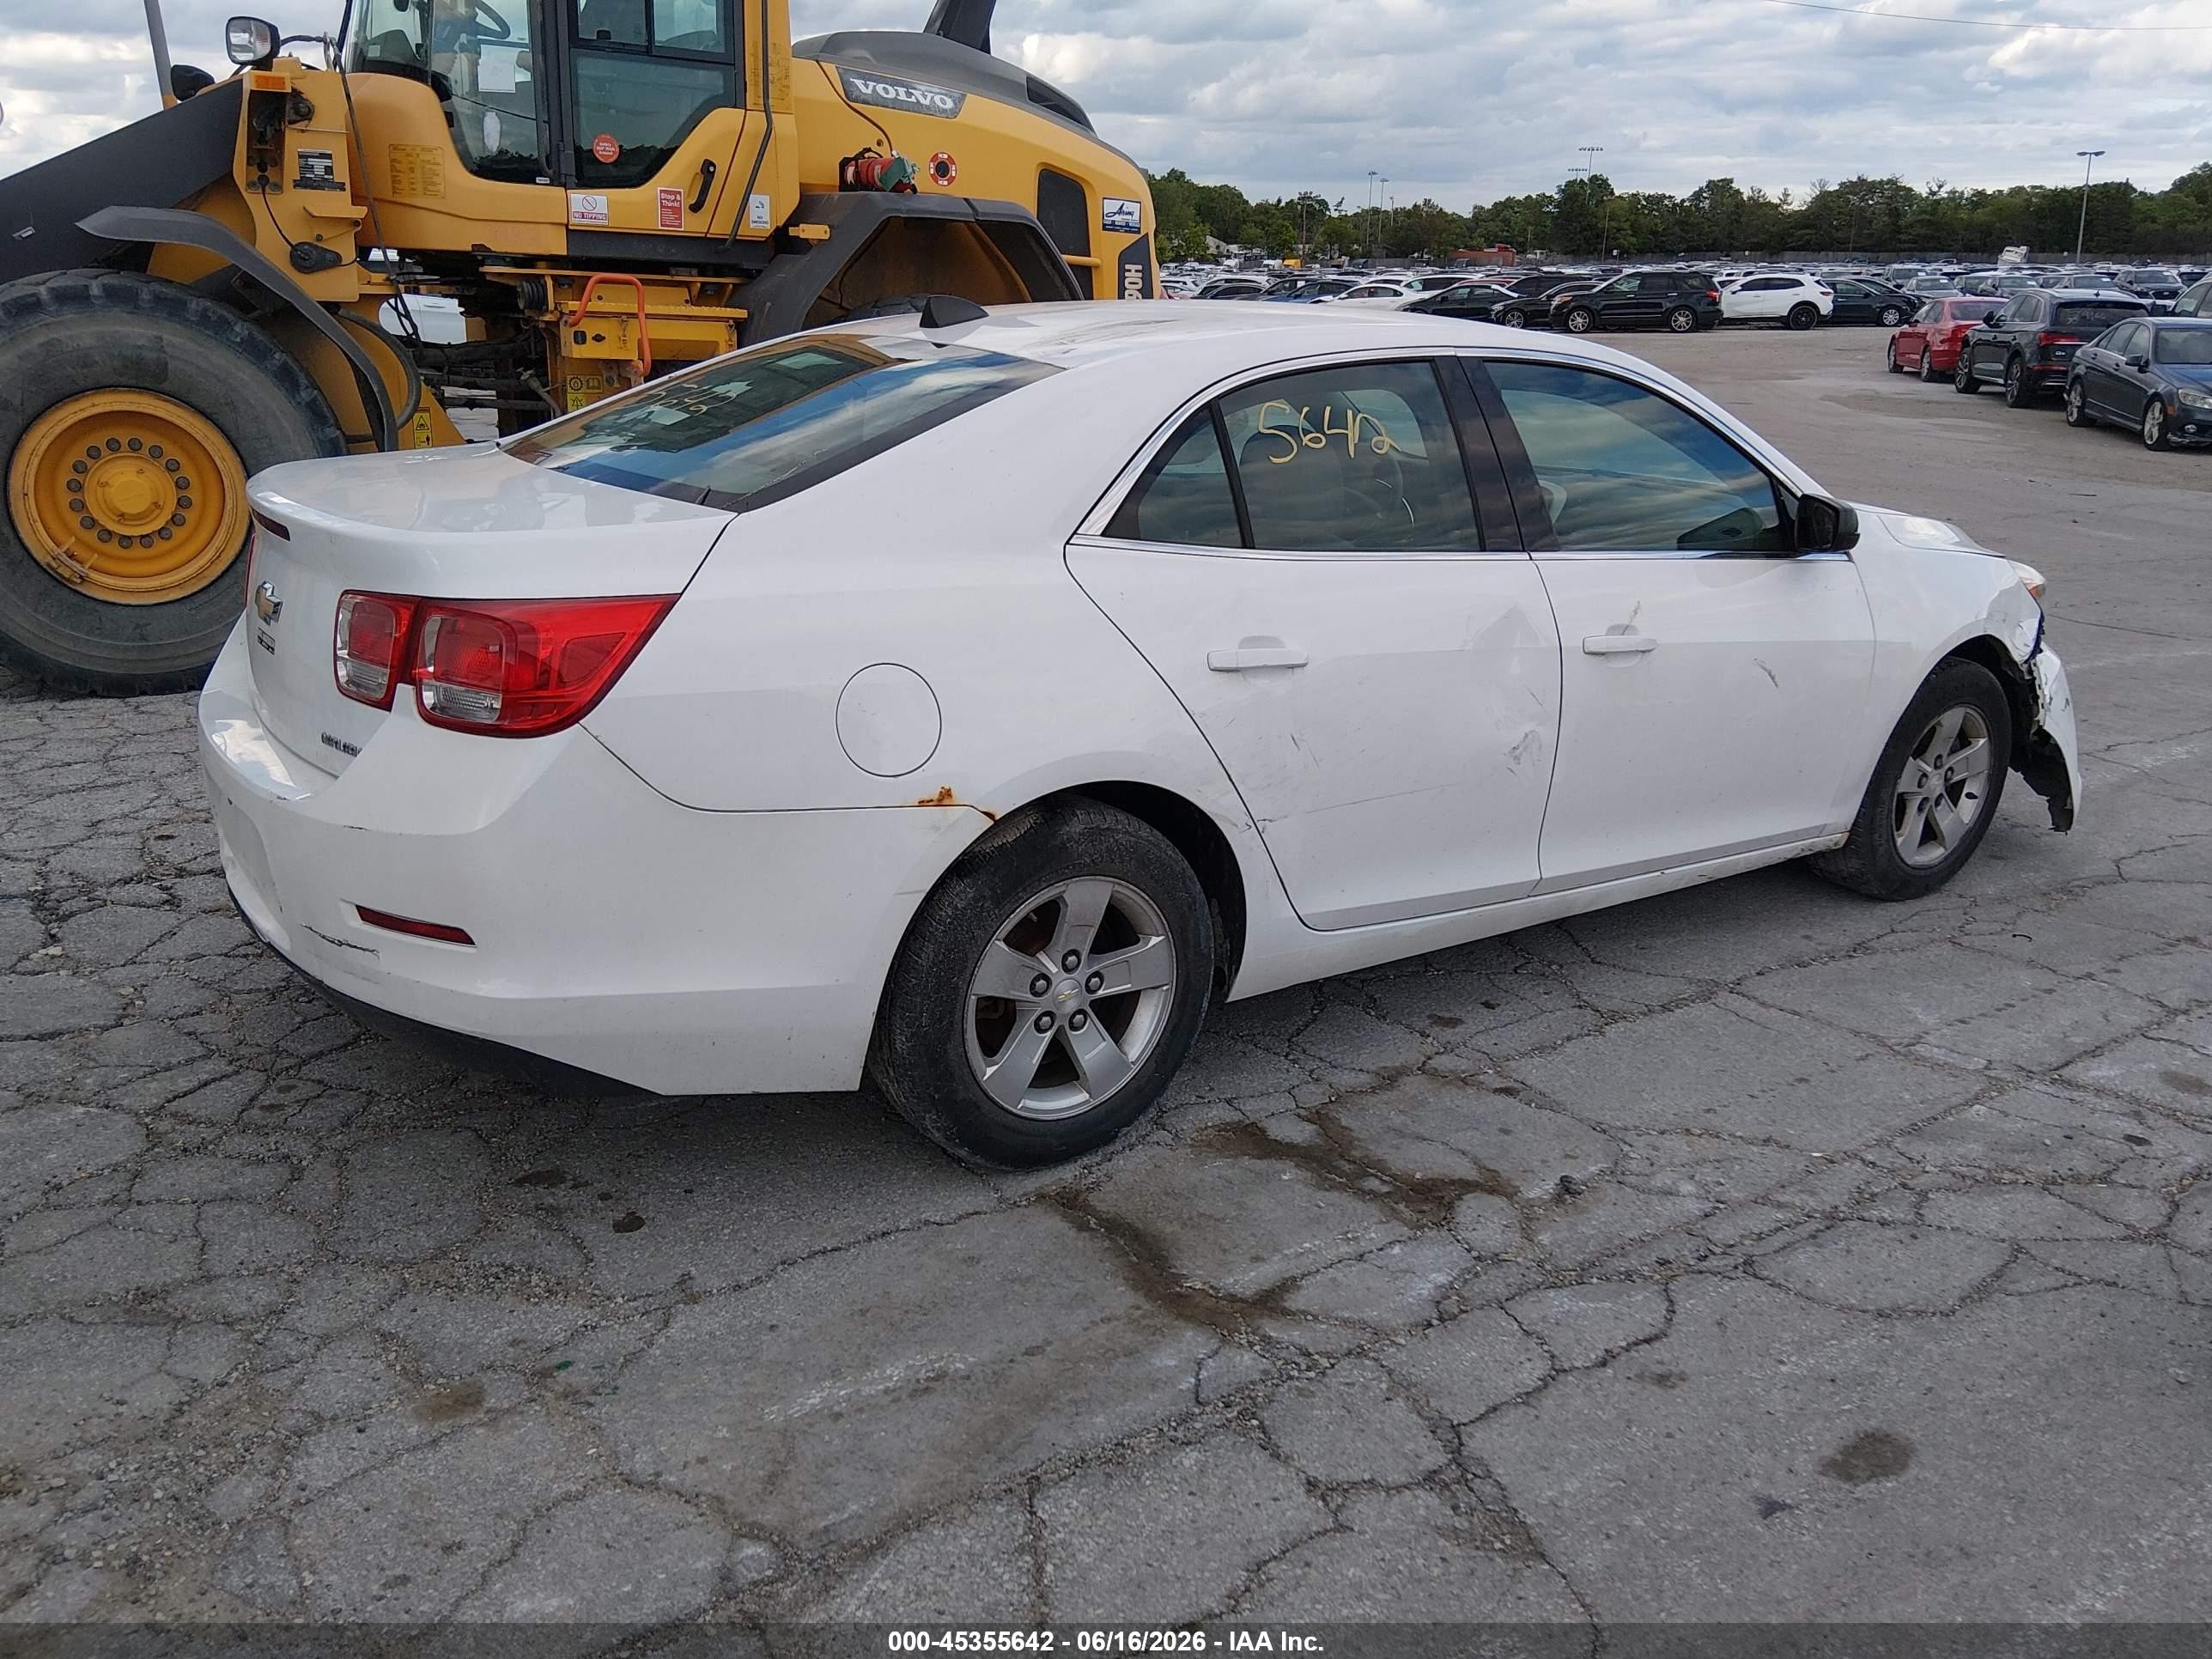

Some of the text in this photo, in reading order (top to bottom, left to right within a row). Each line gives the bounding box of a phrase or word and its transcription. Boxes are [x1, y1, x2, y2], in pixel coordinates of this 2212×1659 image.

[849, 77, 954, 109] VOLVO
[660, 192, 675, 201] Stop
[1258, 402, 1402, 464] 5642
